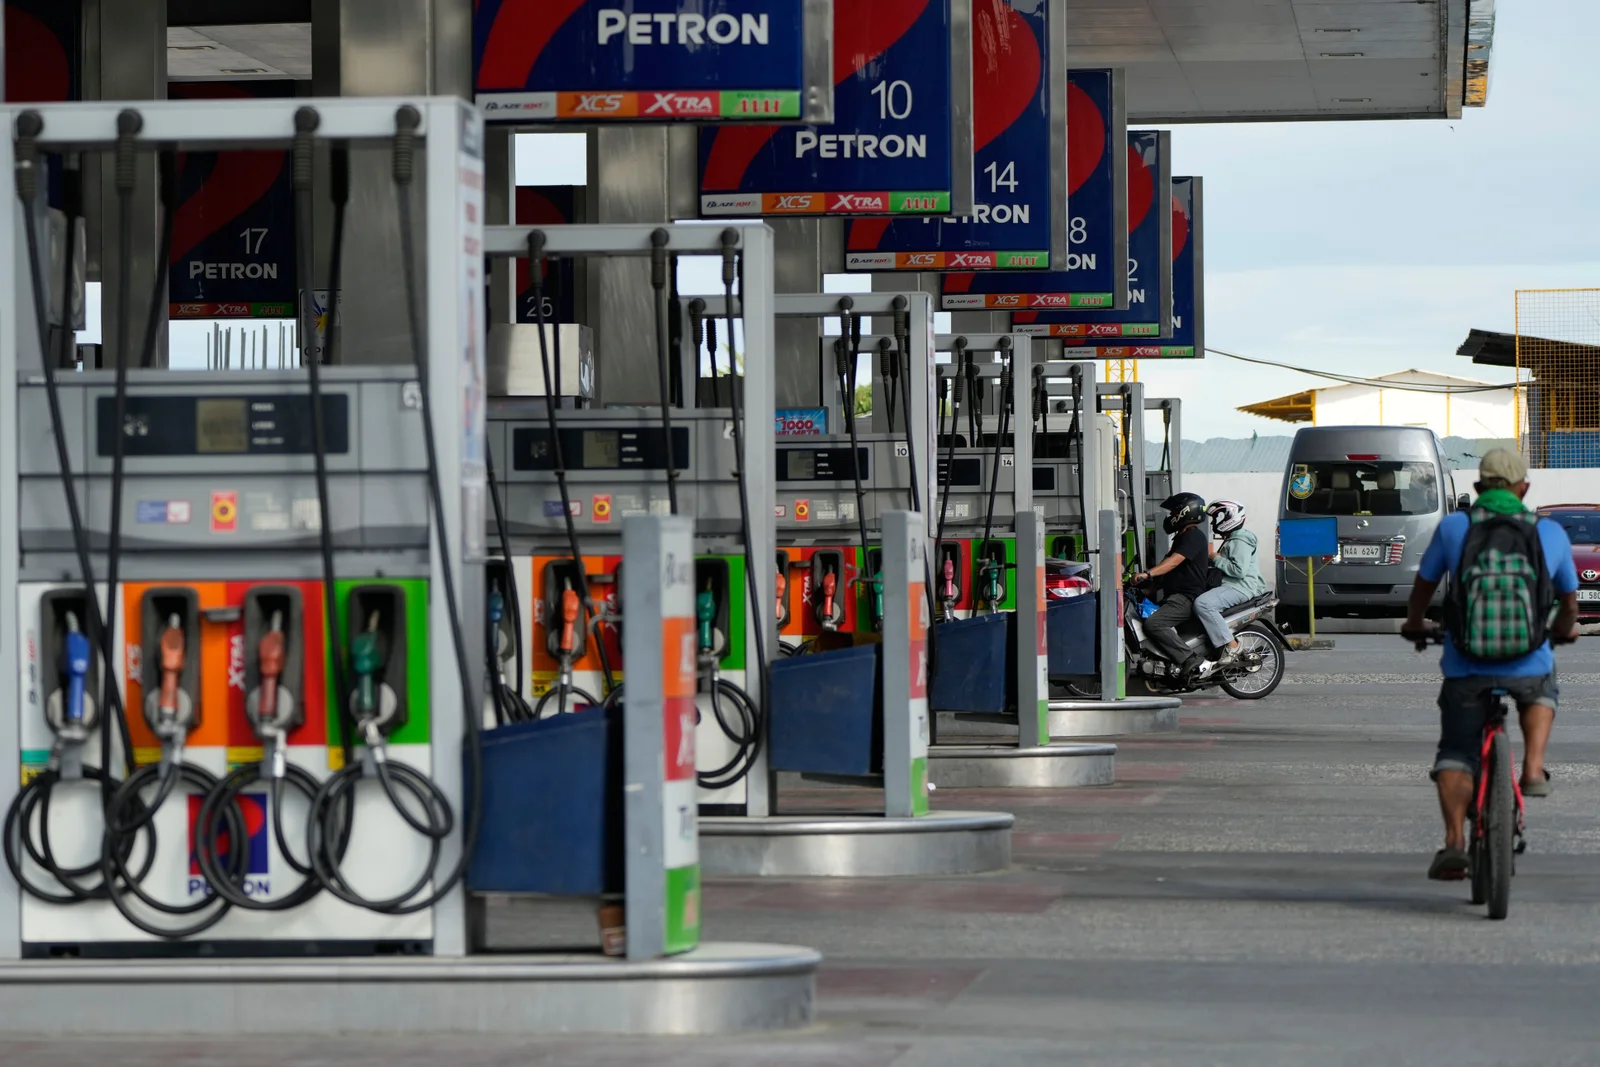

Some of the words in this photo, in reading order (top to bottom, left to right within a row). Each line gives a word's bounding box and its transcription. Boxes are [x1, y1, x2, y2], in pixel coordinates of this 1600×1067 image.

[598, 9, 768, 45] PETRON
[574, 94, 624, 112] XCS
[645, 93, 712, 114] XTRA
[871, 80, 912, 120] 10
[796, 132, 927, 159] PETRON
[984, 161, 1019, 194] 14
[775, 196, 813, 209] XCS
[831, 194, 882, 210] XTRA
[923, 204, 1030, 224] RON
[1069, 216, 1087, 244] 8
[240, 228, 268, 254] 17
[908, 254, 936, 265] XCS
[950, 254, 992, 266] XTRA
[1128, 258, 1138, 282] 2
[190, 261, 278, 280] PETRON
[214, 304, 248, 314] XTRA
[526, 296, 552, 316] 25
[994, 296, 1020, 304] XCS
[1032, 294, 1067, 306] XTRA
[1058, 326, 1079, 334] XCS
[1087, 324, 1118, 334] XTRA
[1134, 347, 1159, 356] XTRA
[782, 420, 814, 430] 1000
[897, 448, 908, 456] 10
[1362, 547, 1379, 556] 6247
[803, 575, 812, 606] XTRA
[228, 634, 246, 691] XTRA
[188, 879, 270, 896] PEON
